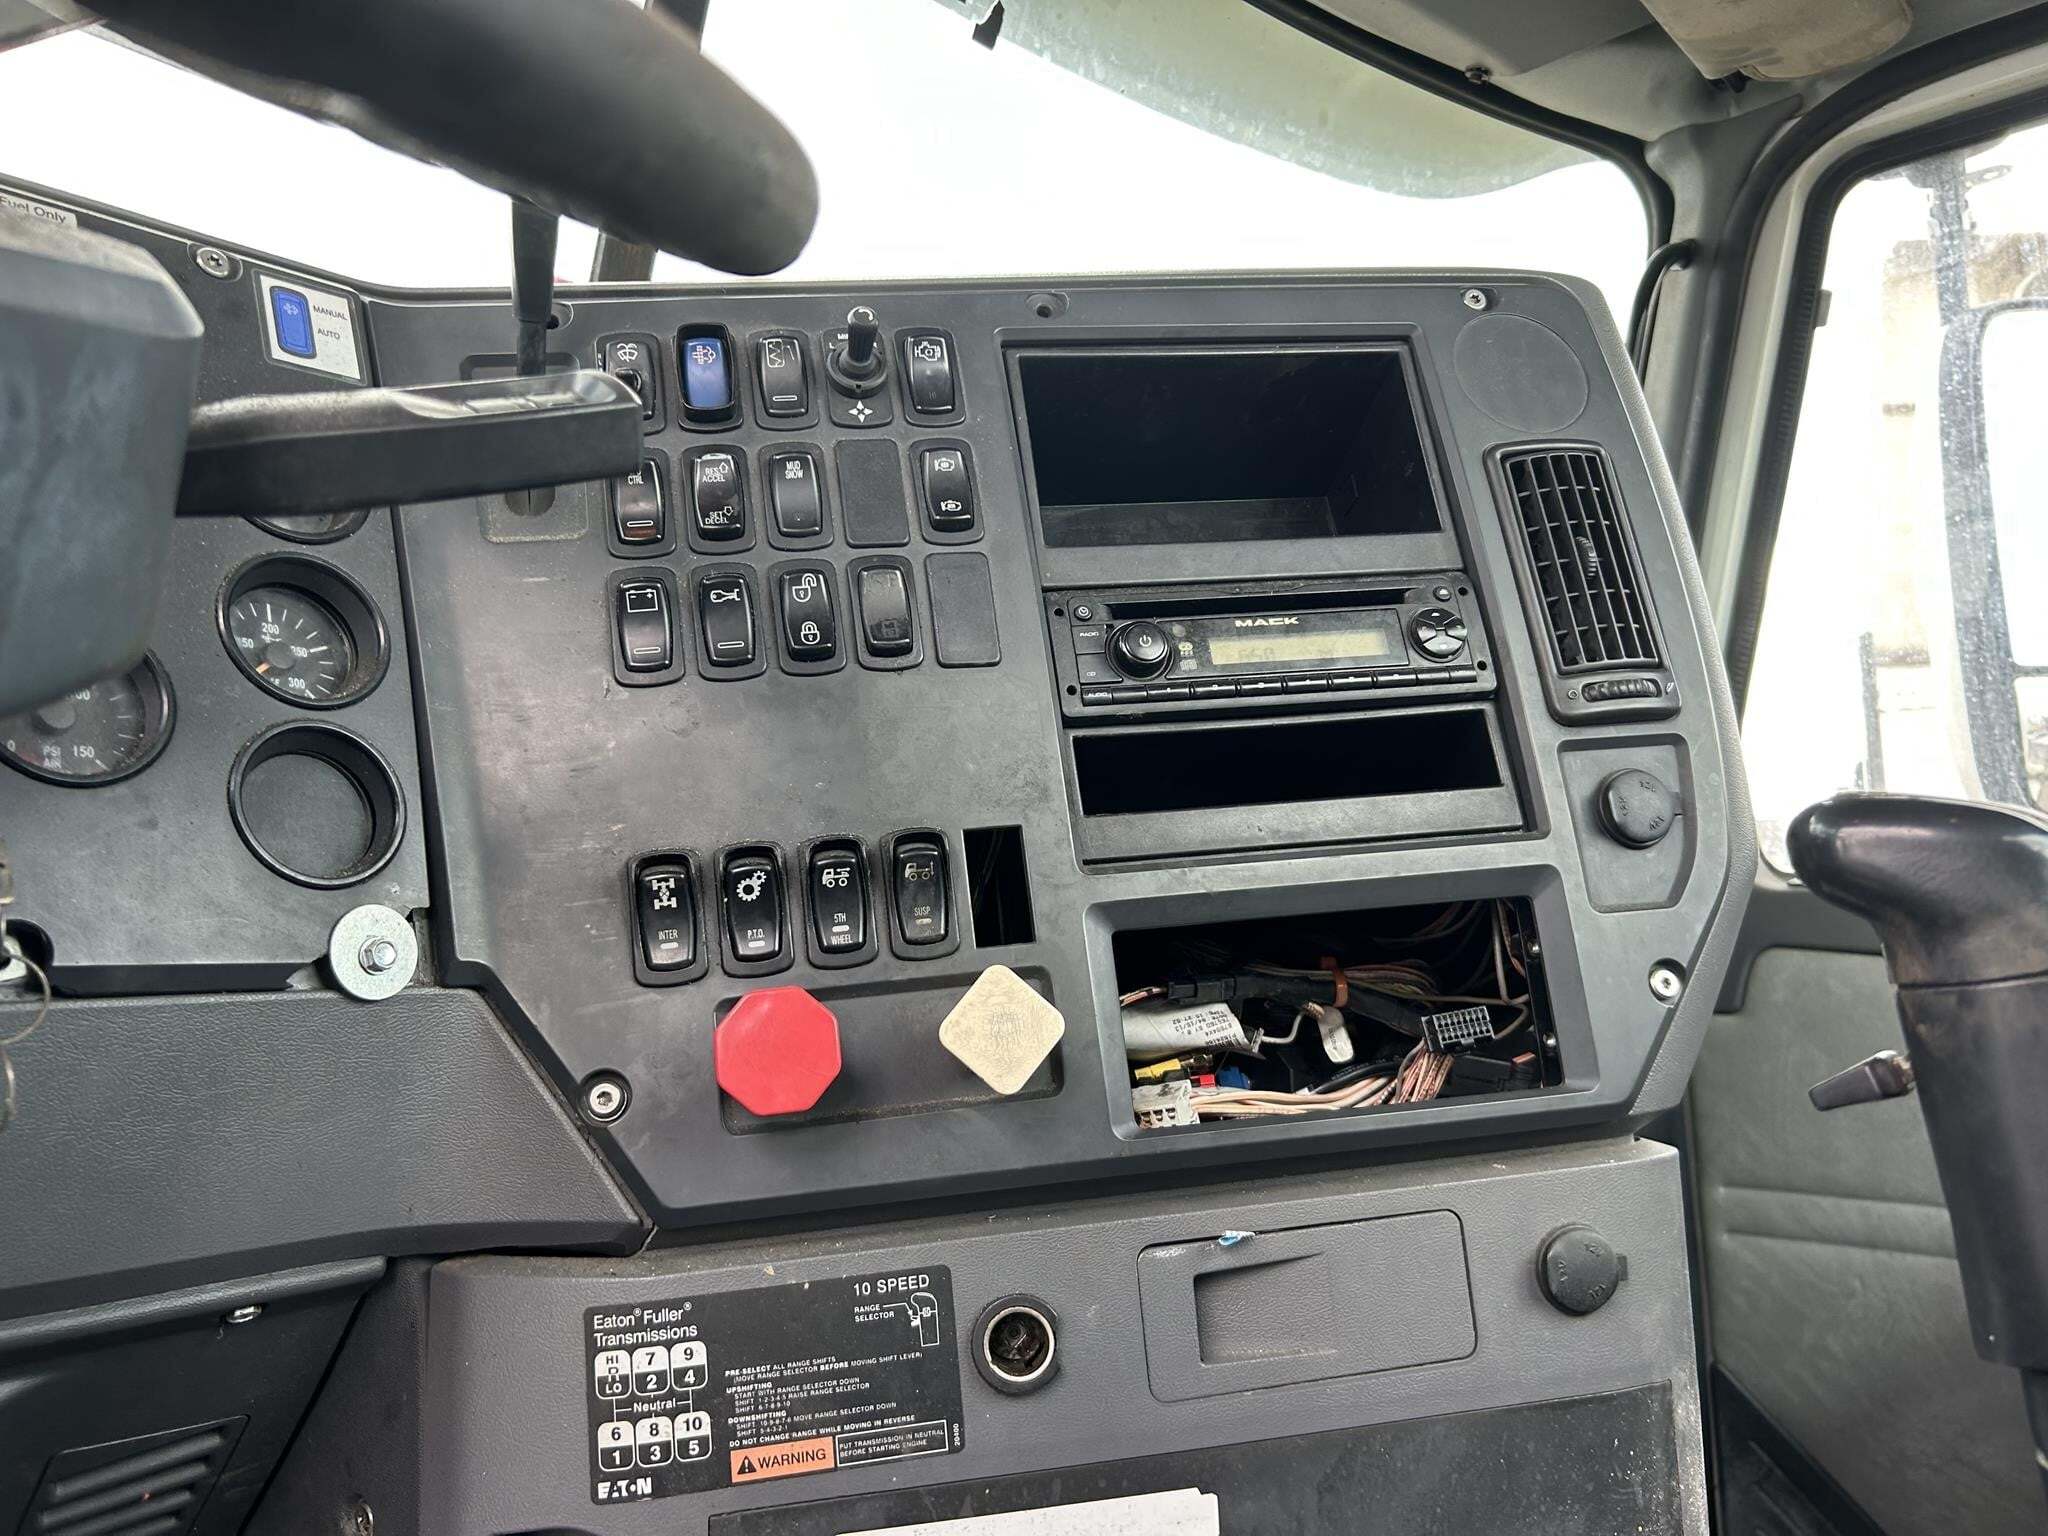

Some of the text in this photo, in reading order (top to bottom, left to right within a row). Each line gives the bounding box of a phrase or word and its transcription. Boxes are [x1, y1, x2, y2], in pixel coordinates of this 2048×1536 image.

[34, 206, 66, 223] Only
[313, 305, 348, 320] MANUAL
[318, 328, 340, 340] AUTO
[786, 460, 800, 470] MUD
[627, 474, 644, 485] CTRL
[702, 474, 725, 483] ACCEL
[785, 470, 803, 479] SNOW
[709, 510, 723, 518] SET
[705, 517, 728, 525] DECEL
[1234, 616, 1299, 627] MACK
[261, 622, 280, 635] 200
[288, 677, 305, 689] 300
[7, 740, 15, 752] 0
[43, 745, 61, 757] PSI
[73, 745, 94, 757] 150
[833, 912, 846, 923] 5TH
[914, 906, 931, 916] SUSP
[658, 929, 679, 940] INTER
[747, 928, 765, 939] P.T.O.
[831, 934, 853, 945] WHEEL
[854, 1274, 930, 1296] 10 SPEED
[854, 1304, 880, 1313] RANGE
[855, 1310, 894, 1322] SELECTOR
[594, 1325, 698, 1347] Transmissions
[606, 1355, 618, 1364] HI
[646, 1352, 655, 1366] 7
[684, 1347, 694, 1360] 9
[725, 1364, 771, 1377] PRE-SELECT
[787, 1360, 810, 1368] RANGE
[812, 1356, 836, 1364] SHIFTS
[757, 1370, 780, 1379] RANGE
[783, 1366, 818, 1376] SELECTOR
[820, 1361, 848, 1371] BEFORE
[850, 1357, 877, 1367] MOVING
[879, 1355, 898, 1363] SHIFT
[646, 1374, 658, 1390] 2
[684, 1369, 695, 1384] 4
[606, 1383, 622, 1393] LO
[726, 1382, 772, 1394] UPSHIFTING
[734, 1391, 755, 1400] START
[777, 1385, 800, 1393] RANGE
[802, 1380, 838, 1390] SELECTOR
[840, 1377, 860, 1385] DOWN
[735, 1398, 754, 1407] SHIFT
[788, 1391, 808, 1399] RAISE
[810, 1387, 833, 1395] RANGE
[836, 1382, 870, 1393] SELECTOR
[633, 1398, 676, 1412] Neutral
[735, 1406, 754, 1414] SHIFT
[728, 1410, 787, 1424] DOWNSHIFTING
[736, 1421, 756, 1430] SHIFT
[794, 1413, 812, 1422] MOVE
[814, 1410, 838, 1418] RANGE
[840, 1405, 874, 1416] SELECTOR
[876, 1402, 897, 1410] DOWN
[649, 1423, 659, 1436] 8
[683, 1417, 702, 1432] 10
[611, 1427, 621, 1441] 6
[729, 1440, 740, 1448] DO
[760, 1433, 790, 1443] CHANGE
[792, 1429, 817, 1438] RANGE
[820, 1425, 841, 1434] WHILE
[844, 1421, 872, 1430] MOVING
[874, 1418, 881, 1426] IN
[884, 1415, 915, 1424] REVERSE
[737, 1428, 756, 1438] SHIFT
[854, 1434, 904, 1447] TRANSMISSION
[914, 1429, 944, 1439] NEUTRAL
[952, 1423, 960, 1446] 20400
[650, 1445, 661, 1461] 3
[688, 1440, 699, 1455] 5
[840, 1439, 927, 1457] BEFORE STARTING ENGINE
[612, 1450, 620, 1464] 1
[758, 1448, 826, 1469] WARNING
